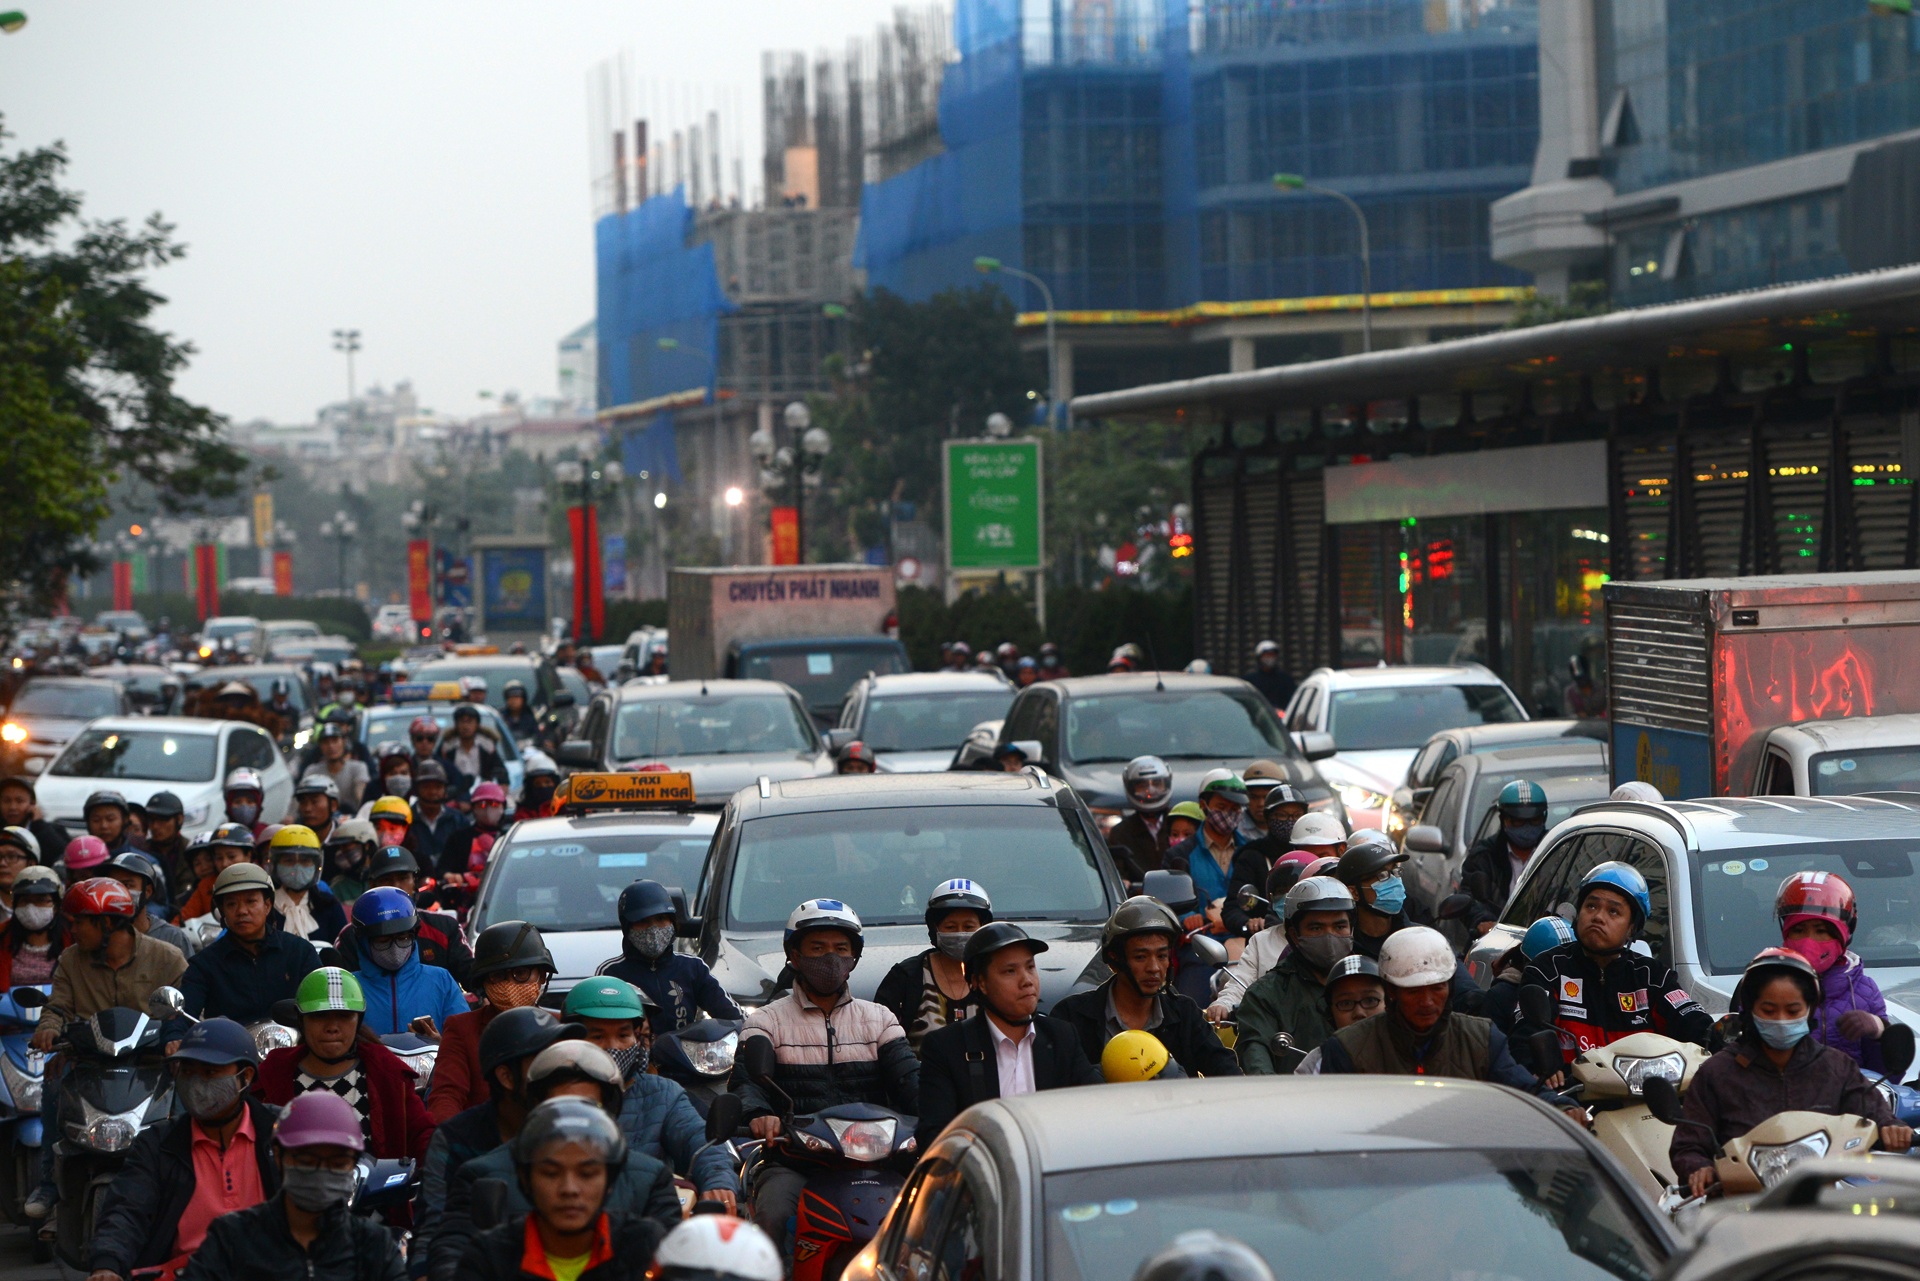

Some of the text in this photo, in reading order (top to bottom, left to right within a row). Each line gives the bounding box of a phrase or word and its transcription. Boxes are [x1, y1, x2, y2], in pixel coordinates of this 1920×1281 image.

[789, 574, 826, 600] PHÁT
[830, 579, 880, 599] NHANH
[630, 776, 661, 785] TAXI
[607, 787, 689, 799] THANH NGA
